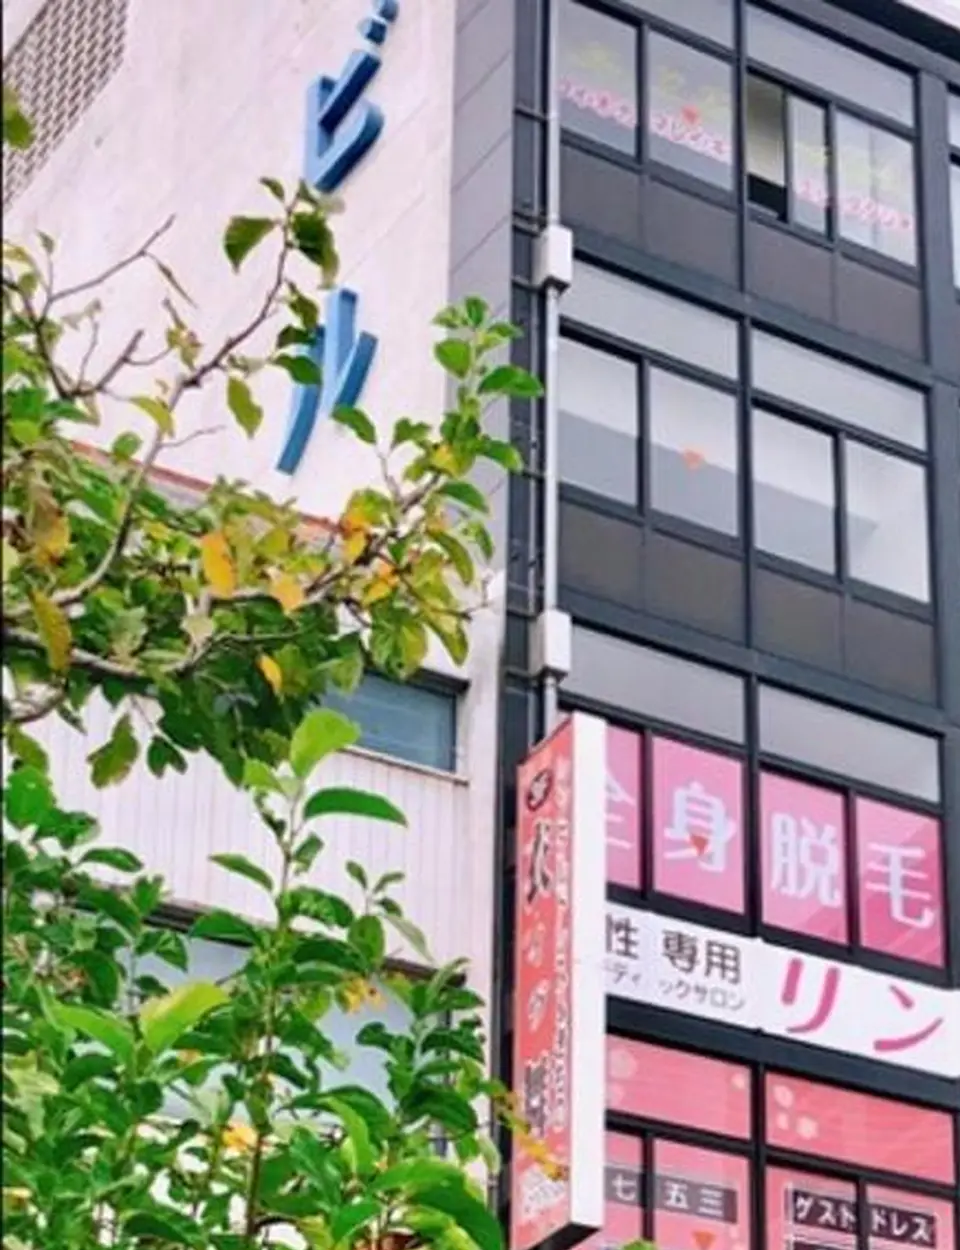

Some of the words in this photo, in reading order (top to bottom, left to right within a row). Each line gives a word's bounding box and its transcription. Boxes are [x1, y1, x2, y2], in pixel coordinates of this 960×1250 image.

[611, 1173, 725, 1218] 七五三
[795, 1195, 932, 1243] ゲストドレス
